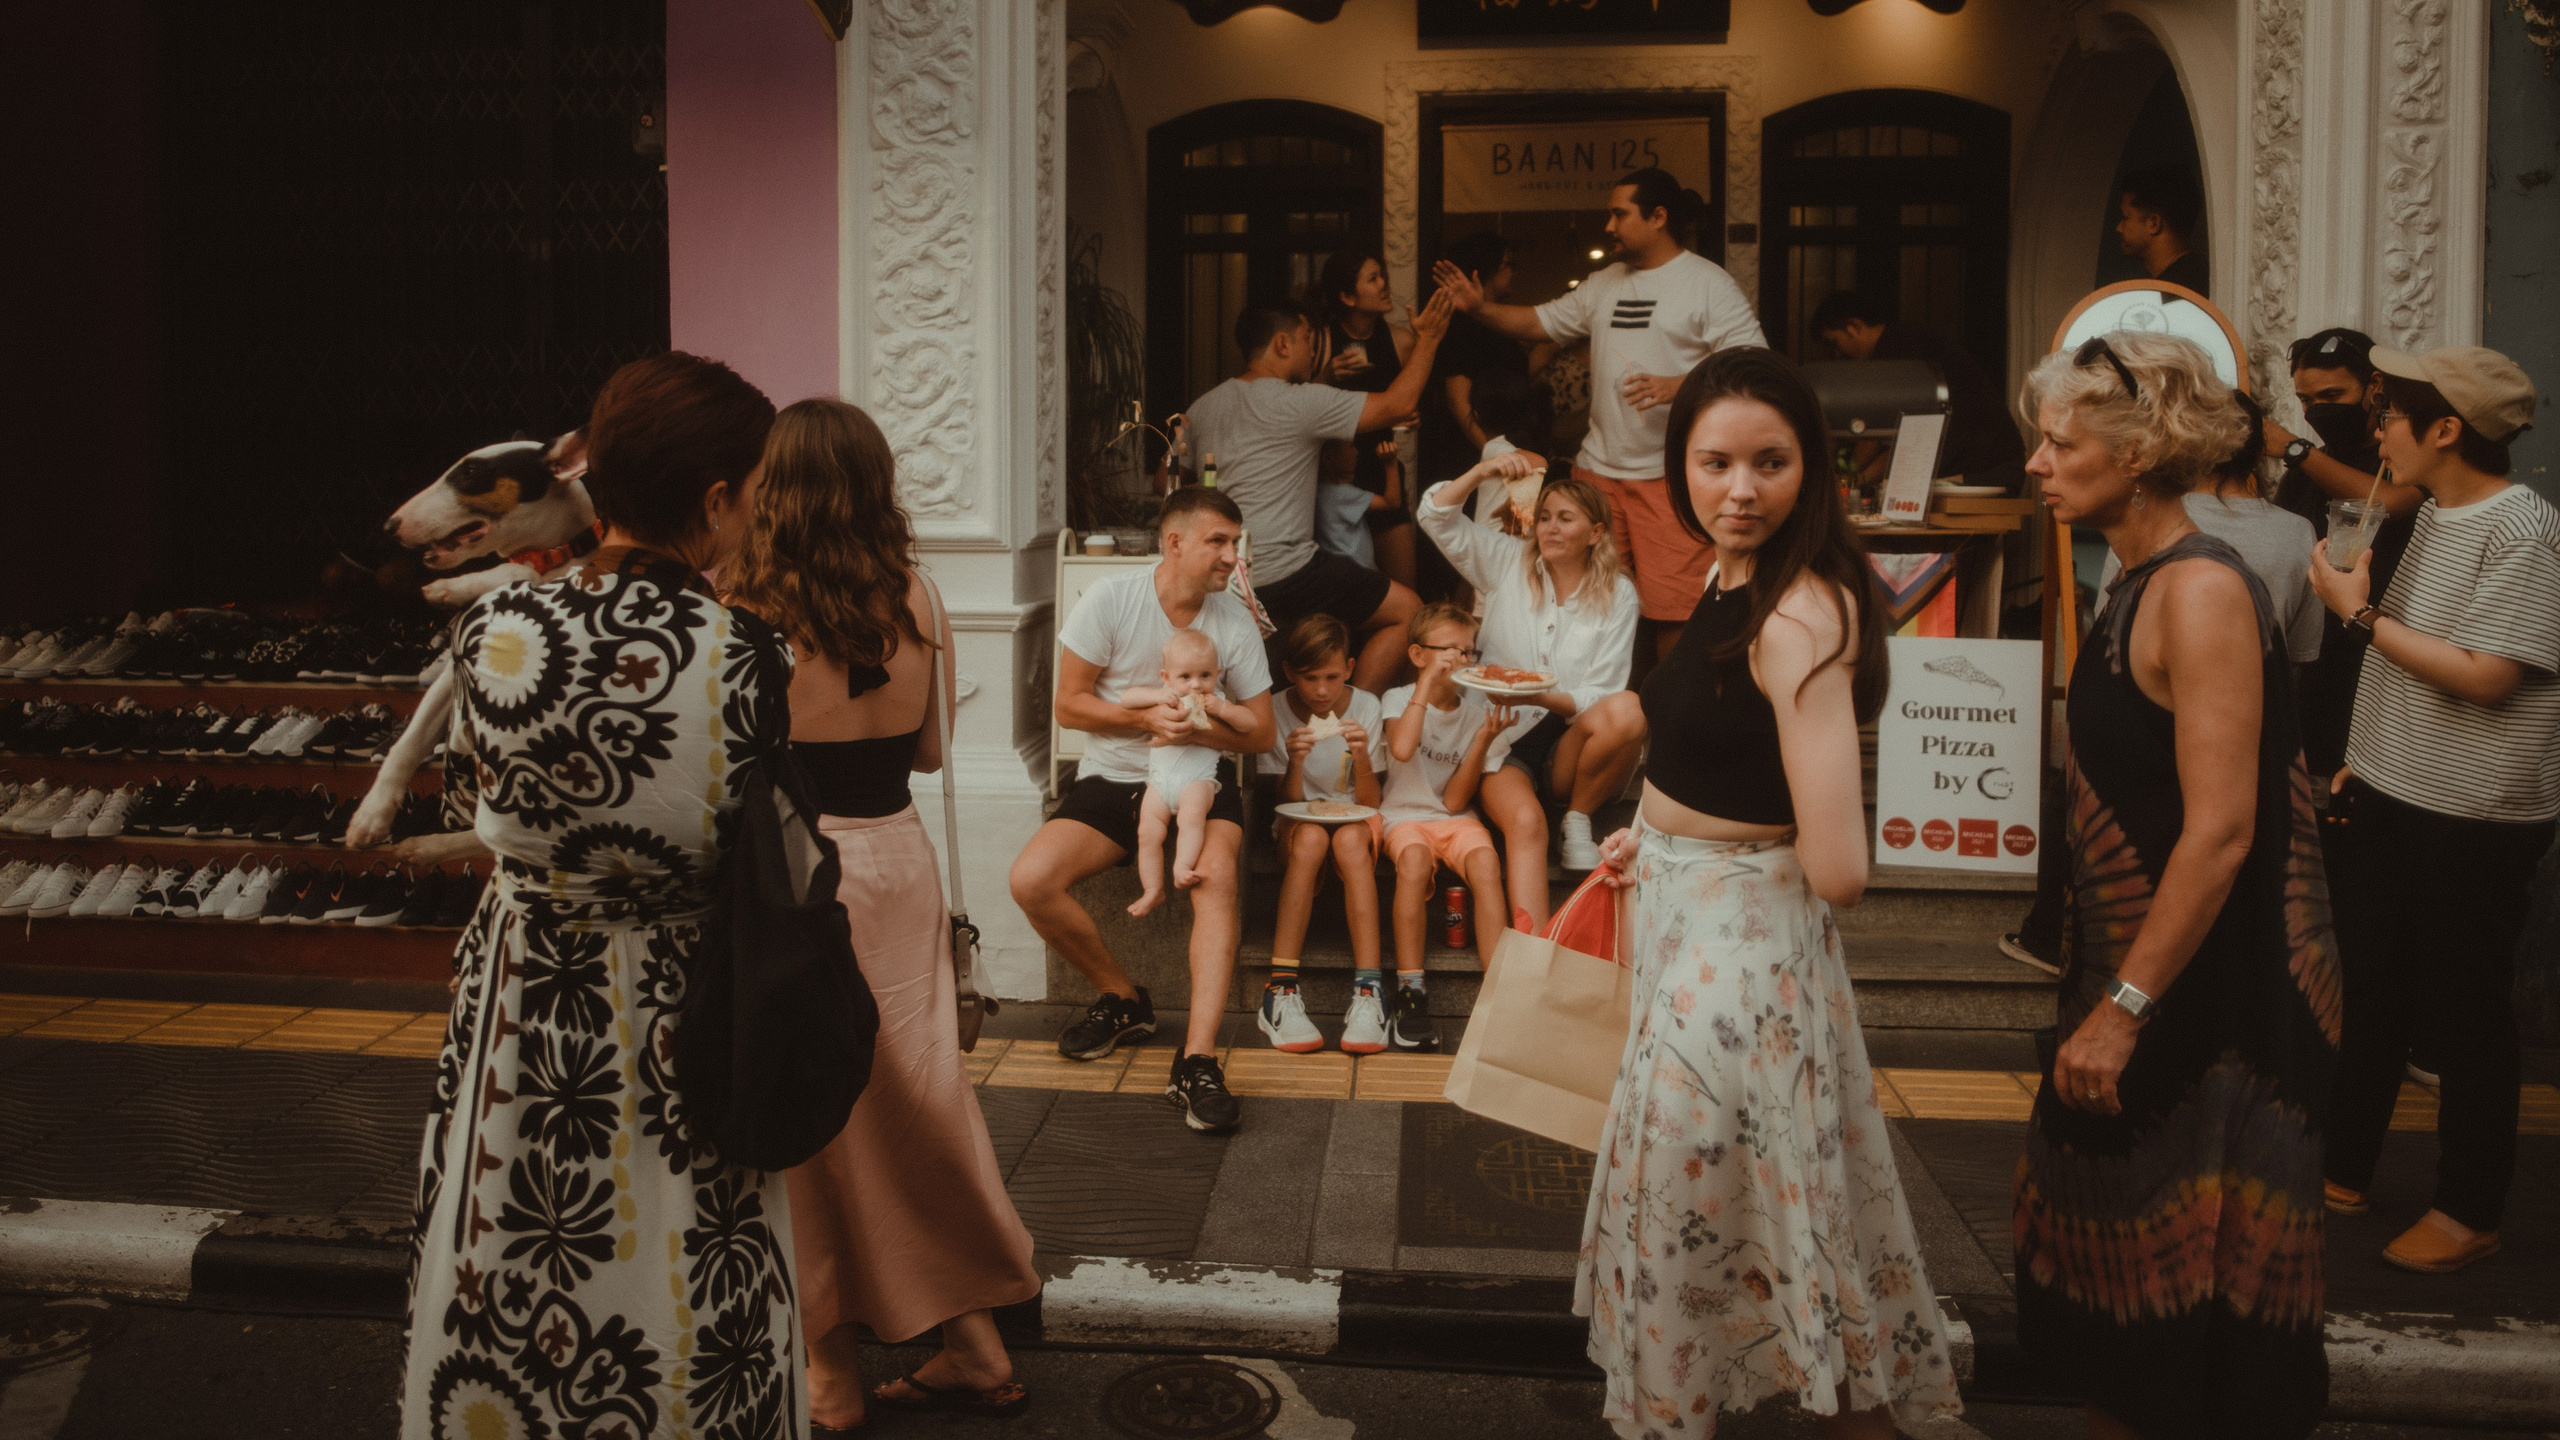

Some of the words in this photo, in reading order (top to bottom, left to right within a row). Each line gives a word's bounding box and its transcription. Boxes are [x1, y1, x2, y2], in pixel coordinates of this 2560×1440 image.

[1492, 141, 1595, 175] BAAN
[1610, 137, 1660, 170] 125
[1901, 700, 2017, 724] Gourmet
[1921, 735, 1996, 758] Pizza
[1933, 771, 1968, 794] by
[1962, 831, 1994, 839] MICHELIN
